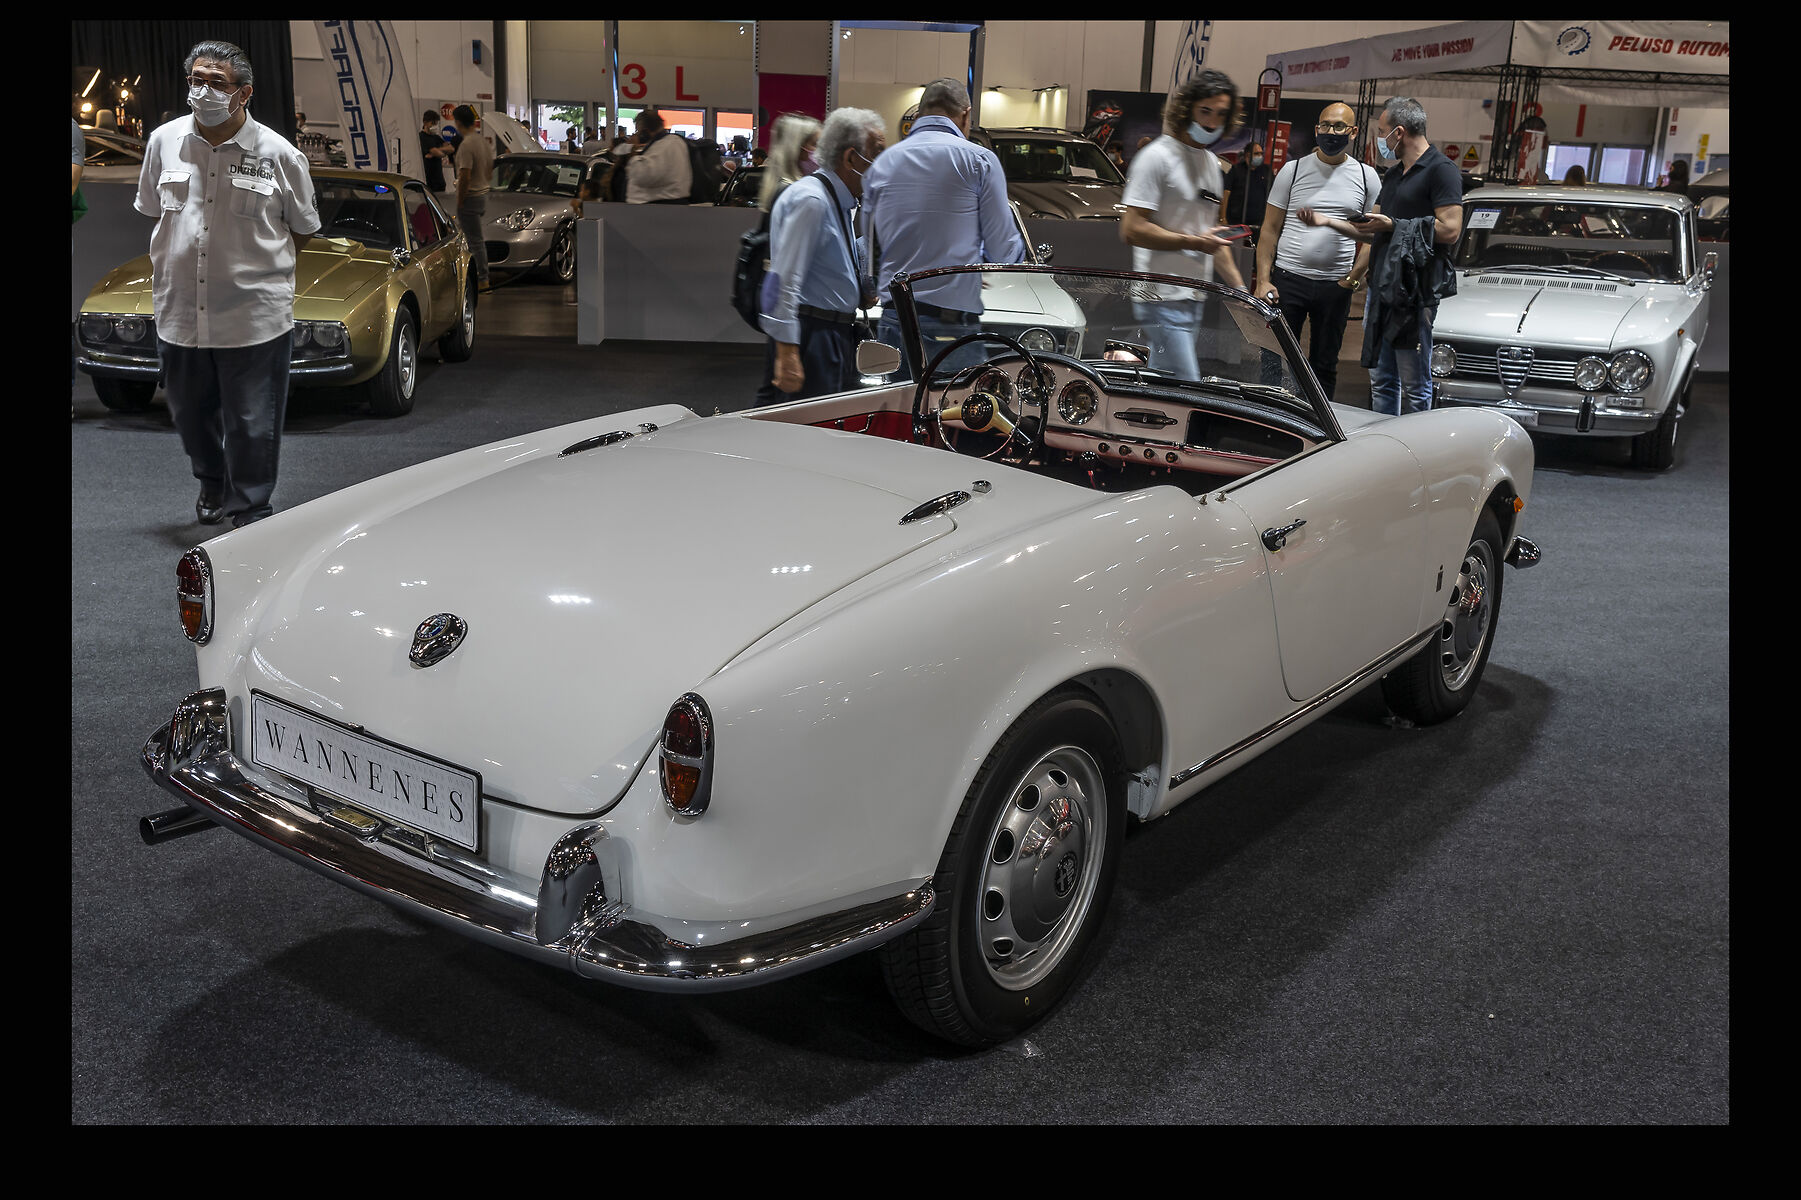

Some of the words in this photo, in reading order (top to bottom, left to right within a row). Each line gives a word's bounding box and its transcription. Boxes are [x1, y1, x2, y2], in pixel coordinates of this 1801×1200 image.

[1608, 35, 1674, 54] PELUSO
[675, 66, 700, 101] L
[265, 718, 464, 823] WANNENES
